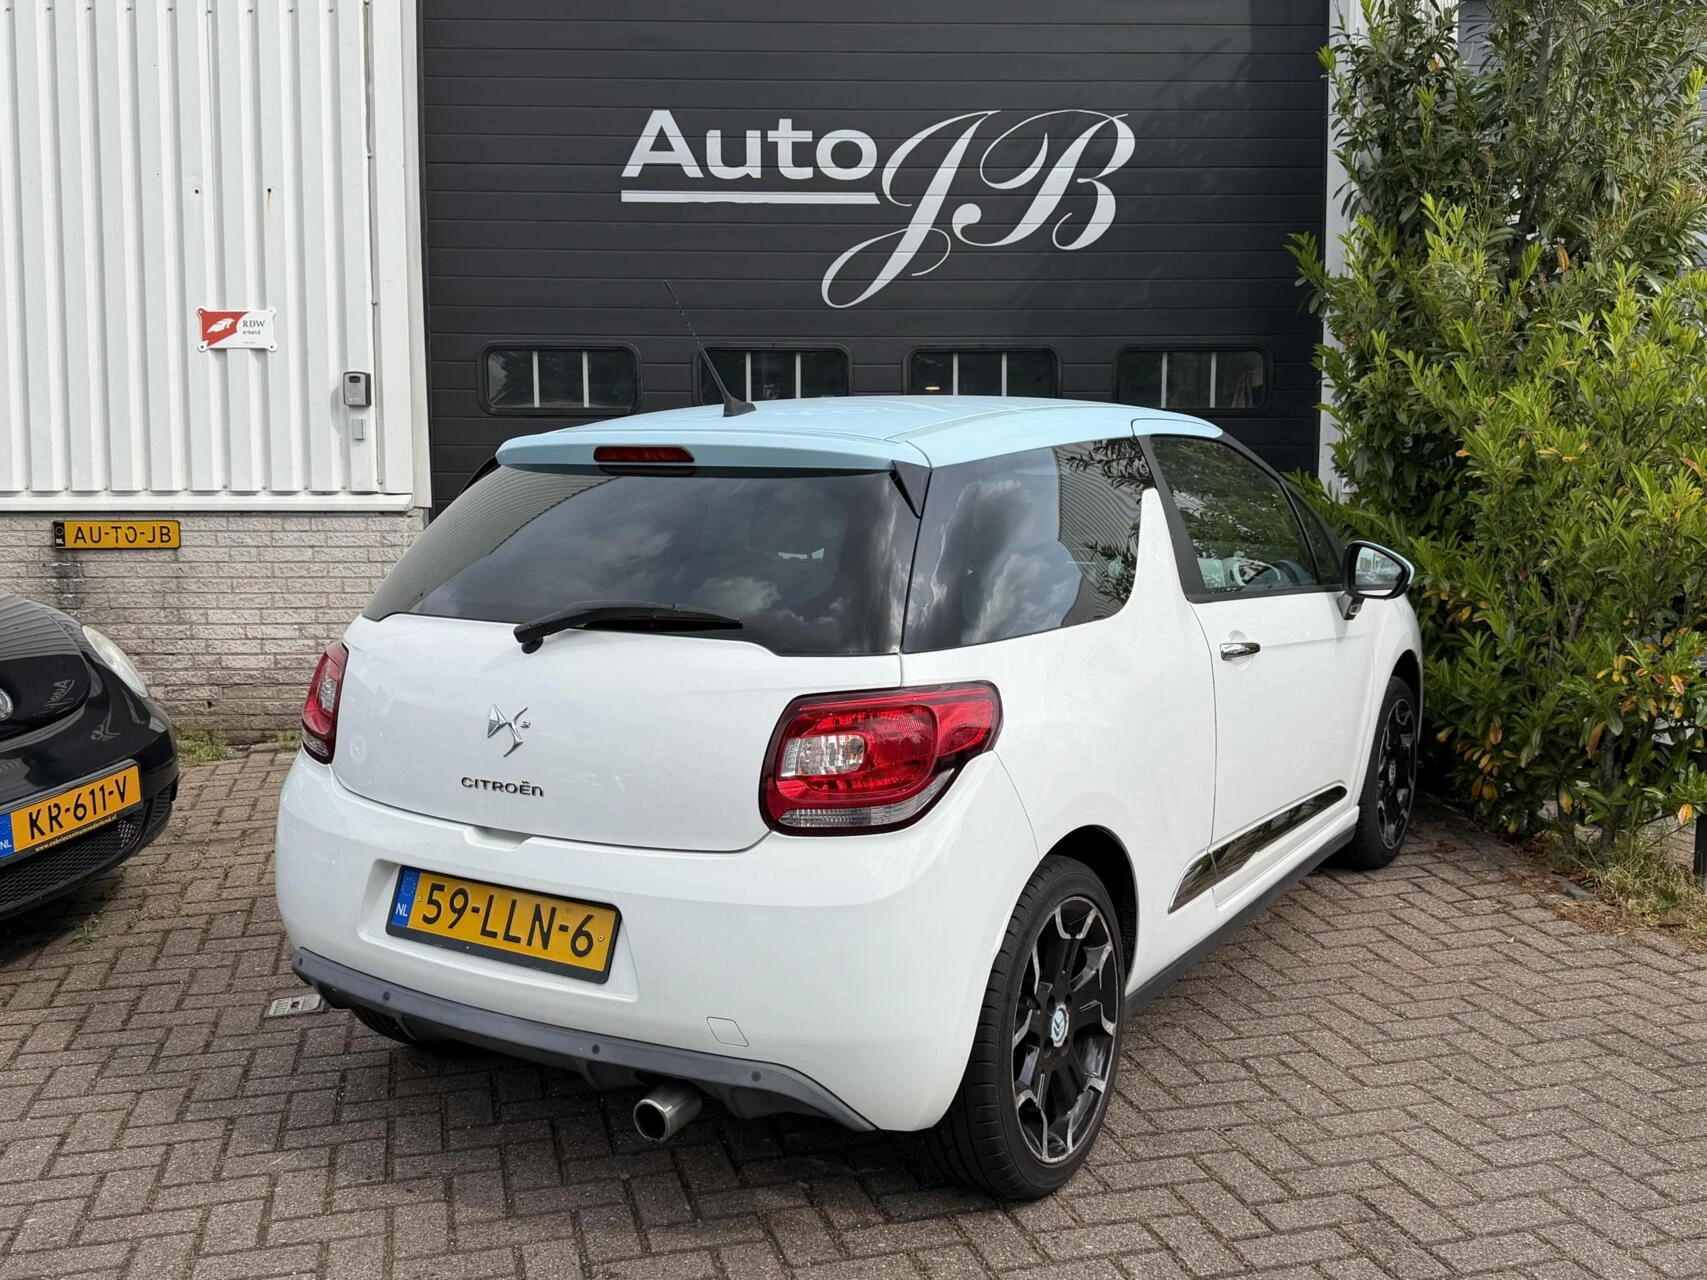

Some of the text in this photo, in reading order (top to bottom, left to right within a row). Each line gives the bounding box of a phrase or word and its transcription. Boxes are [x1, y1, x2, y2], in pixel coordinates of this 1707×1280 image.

[621, 109, 1136, 308] Auto JB
[242, 320, 266, 328] RDW
[73, 526, 172, 544] AU-TO-JB
[28, 775, 128, 840] KR-611-V
[0, 839, 12, 850] NL
[395, 902, 408, 917] NL
[421, 882, 595, 958] 59-LLN-6
